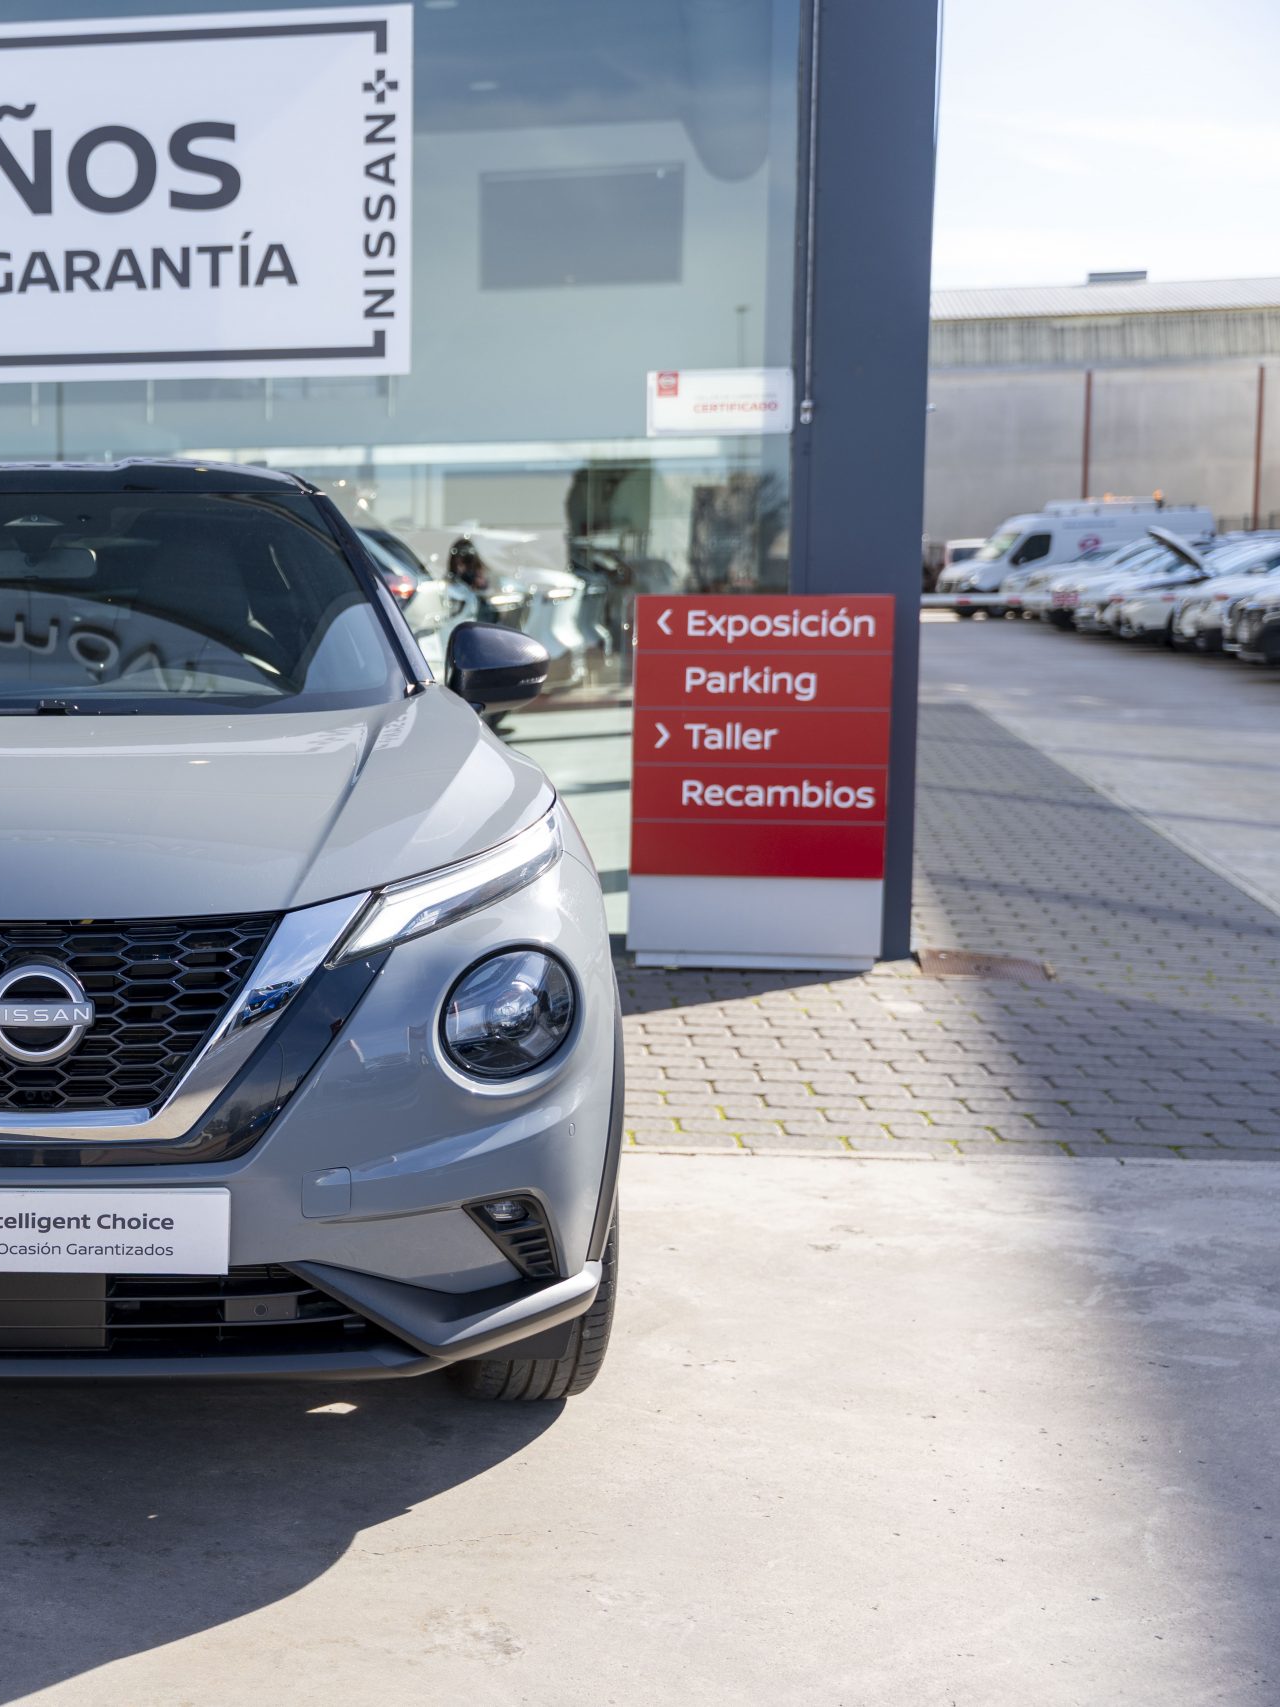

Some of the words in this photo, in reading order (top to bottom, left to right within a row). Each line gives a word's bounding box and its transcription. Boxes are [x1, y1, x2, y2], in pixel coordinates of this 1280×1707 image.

[693, 400, 779, 413] CERTIFICADO
[686, 607, 876, 644] Exposición
[685, 666, 817, 701] Parking
[683, 722, 778, 751] Taller
[681, 779, 875, 809] Recambios
[96, 1213, 175, 1231] Choice
[66, 1242, 174, 1256] Garantizados
